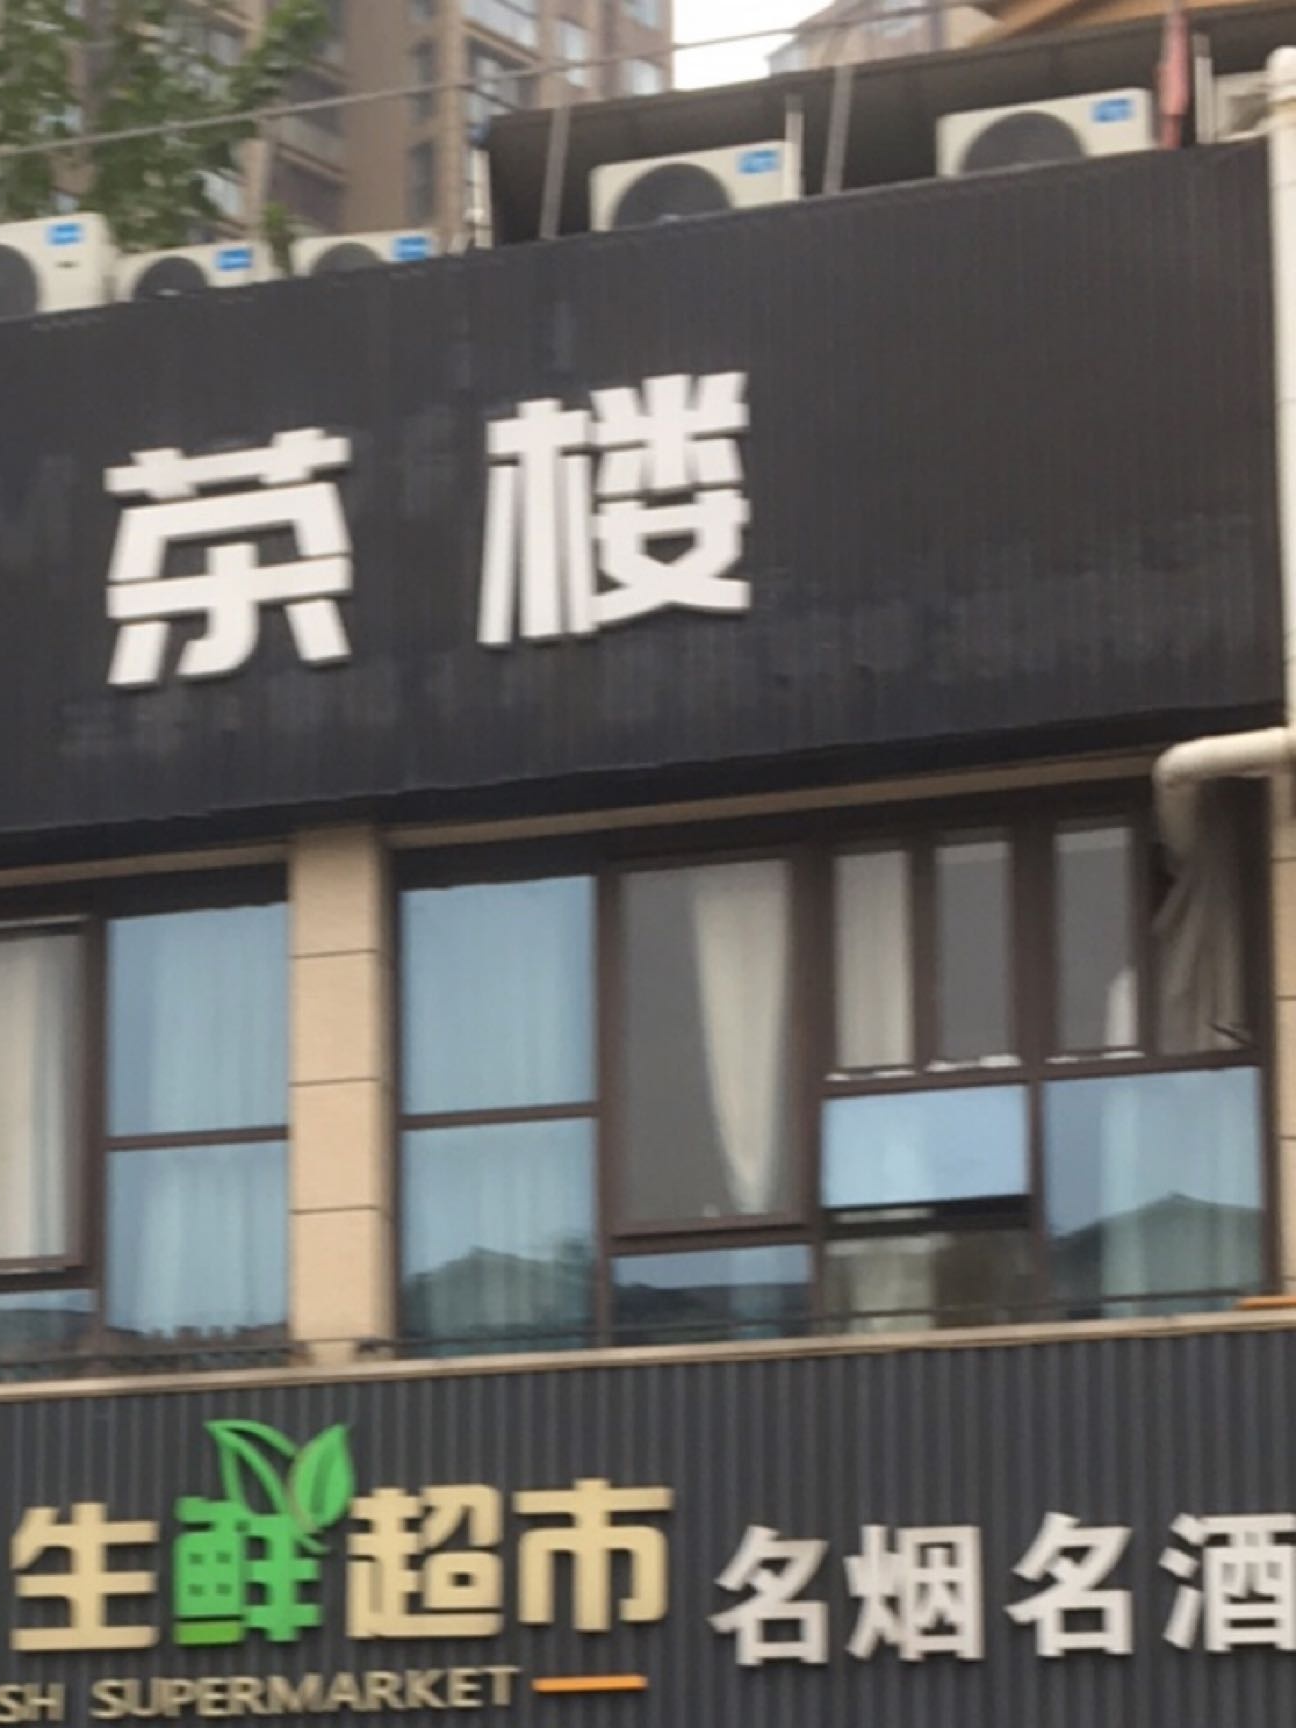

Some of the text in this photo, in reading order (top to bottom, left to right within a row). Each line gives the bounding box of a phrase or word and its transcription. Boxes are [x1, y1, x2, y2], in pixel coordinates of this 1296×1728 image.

[104, 371, 751, 686] 茶楼
[710, 1511, 1296, 1667] 名烟名酒
[90, 1664, 522, 1720] SUPERMARKET
